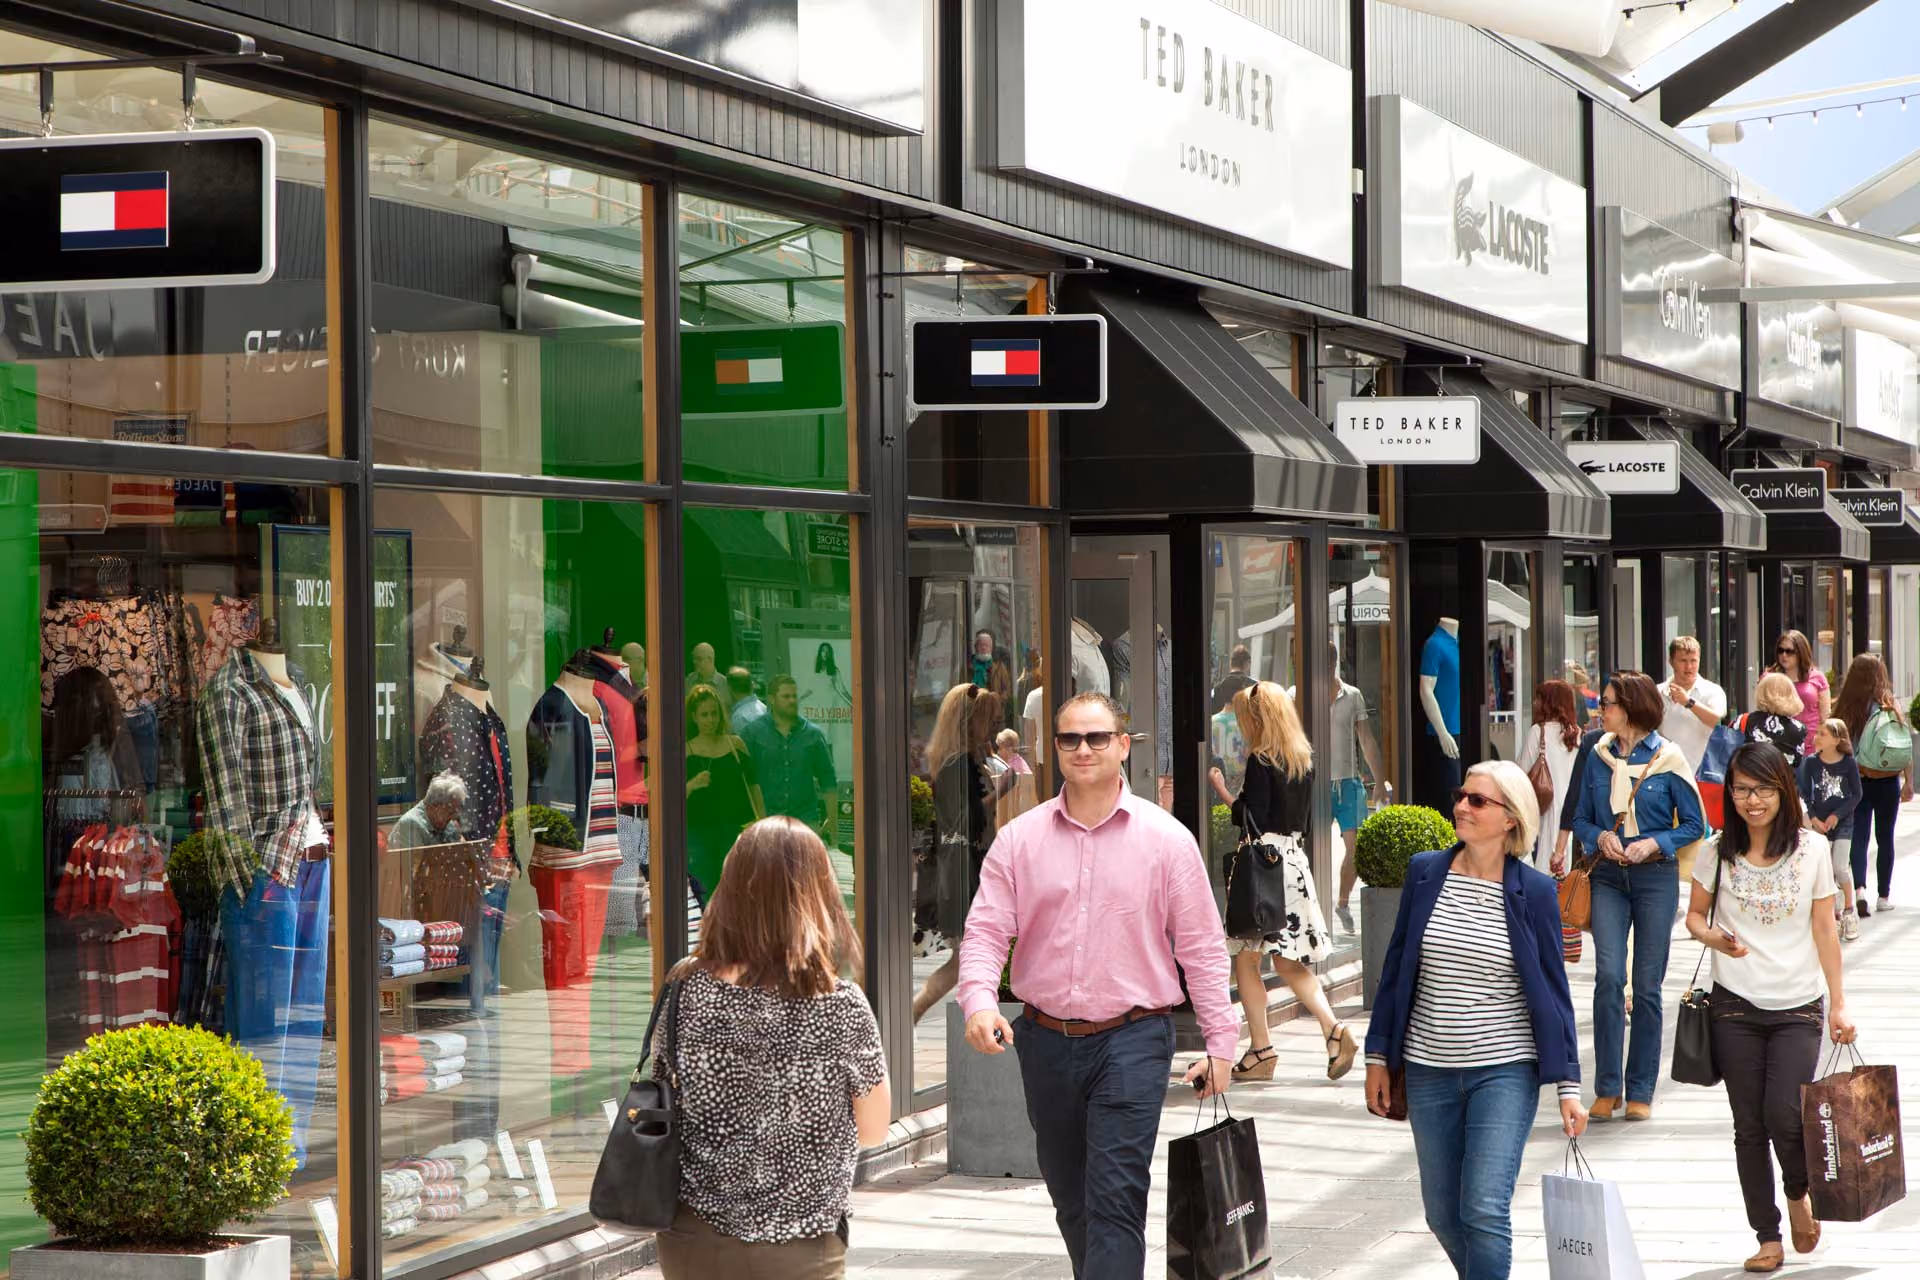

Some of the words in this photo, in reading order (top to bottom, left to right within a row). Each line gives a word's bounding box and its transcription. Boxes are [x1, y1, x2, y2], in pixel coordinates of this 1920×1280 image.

[1140, 17, 1185, 93] TED
[1204, 46, 1274, 132] BAKER
[1180, 142, 1241, 187] LONDON
[1489, 200, 1549, 275] LACOSTE
[1660, 271, 1690, 335] Calvin
[1689, 279, 1711, 342] Klein
[1350, 417, 1384, 430] TED
[1401, 417, 1462, 430] BAKER
[1608, 462, 1666, 473] LACOSTE
[1739, 483, 1782, 498] Calvin
[1785, 482, 1819, 498] Klein
[1839, 498, 1867, 511] alvin
[1869, 498, 1898, 511] Klein
[296, 579, 315, 606] BUY
[317, 579, 324, 606] 2
[375, 682, 397, 740] FF
[1820, 1119, 1838, 1182] Timberland
[1860, 1135, 1889, 1158] Timberland
[1557, 1236, 1594, 1257] JAEGER
